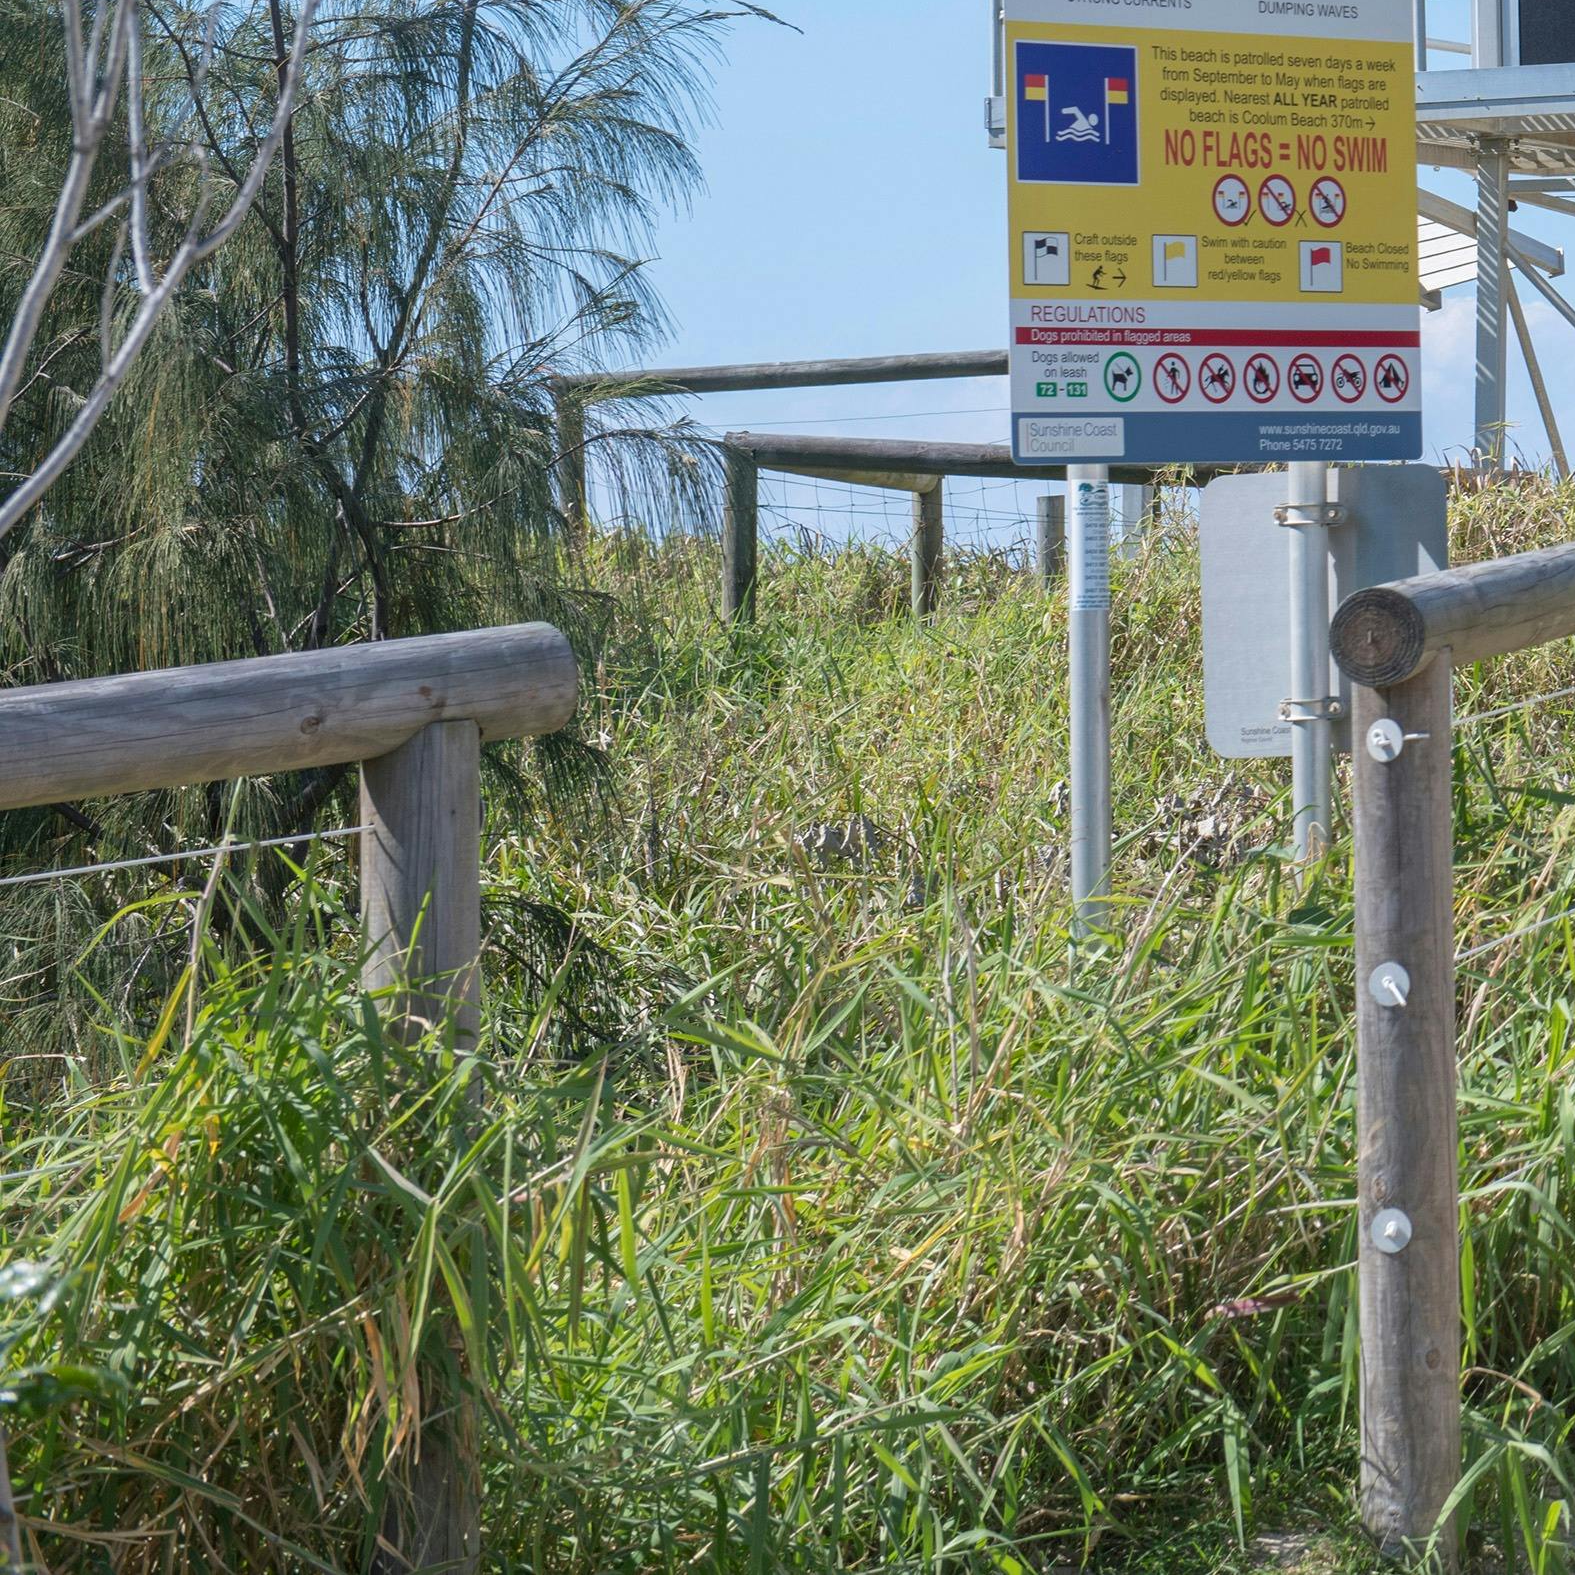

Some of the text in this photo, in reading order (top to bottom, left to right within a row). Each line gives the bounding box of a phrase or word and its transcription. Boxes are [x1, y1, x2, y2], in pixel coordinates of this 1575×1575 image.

[1258, 0, 1359, 19] DUMPING WAVES
[1152, 46, 1396, 73] This beach is patrolled seven days a week
[1162, 66, 1386, 93] from September to May when flags are
[1160, 87, 1389, 111] displayed. Nearest ALL YEAR patrolled
[1189, 108, 1363, 128] beach is Coolum Beach 370m
[1164, 129, 1196, 166] NO
[1203, 130, 1273, 169] FLAGS
[1297, 134, 1327, 171] NO
[1333, 135, 1387, 173] SWIM
[1074, 233, 1138, 247] Craft outside
[1201, 236, 1287, 249] Swim with caution
[1345, 242, 1409, 254] Beach Closed
[1074, 250, 1129, 264] these flags
[1224, 253, 1264, 265] between
[1346, 258, 1409, 273] No Swimming
[1207, 269, 1282, 283] red/yellow flags
[1031, 305, 1146, 323] REGULATIONS
[1031, 329, 1191, 344] Dogs prohibited in flagged areas
[1032, 351, 1099, 365] Dogs allowed
[1044, 367, 1087, 378] on leash
[1040, 384, 1054, 395] 72
[1068, 384, 1087, 395] 131
[1030, 422, 1118, 437] Sunshine Coast
[1259, 423, 1400, 437] www.sunshinecoast.qld.gov.au
[1030, 438, 1075, 452] Council
[1259, 438, 1343, 451] Phone 5475 7272
